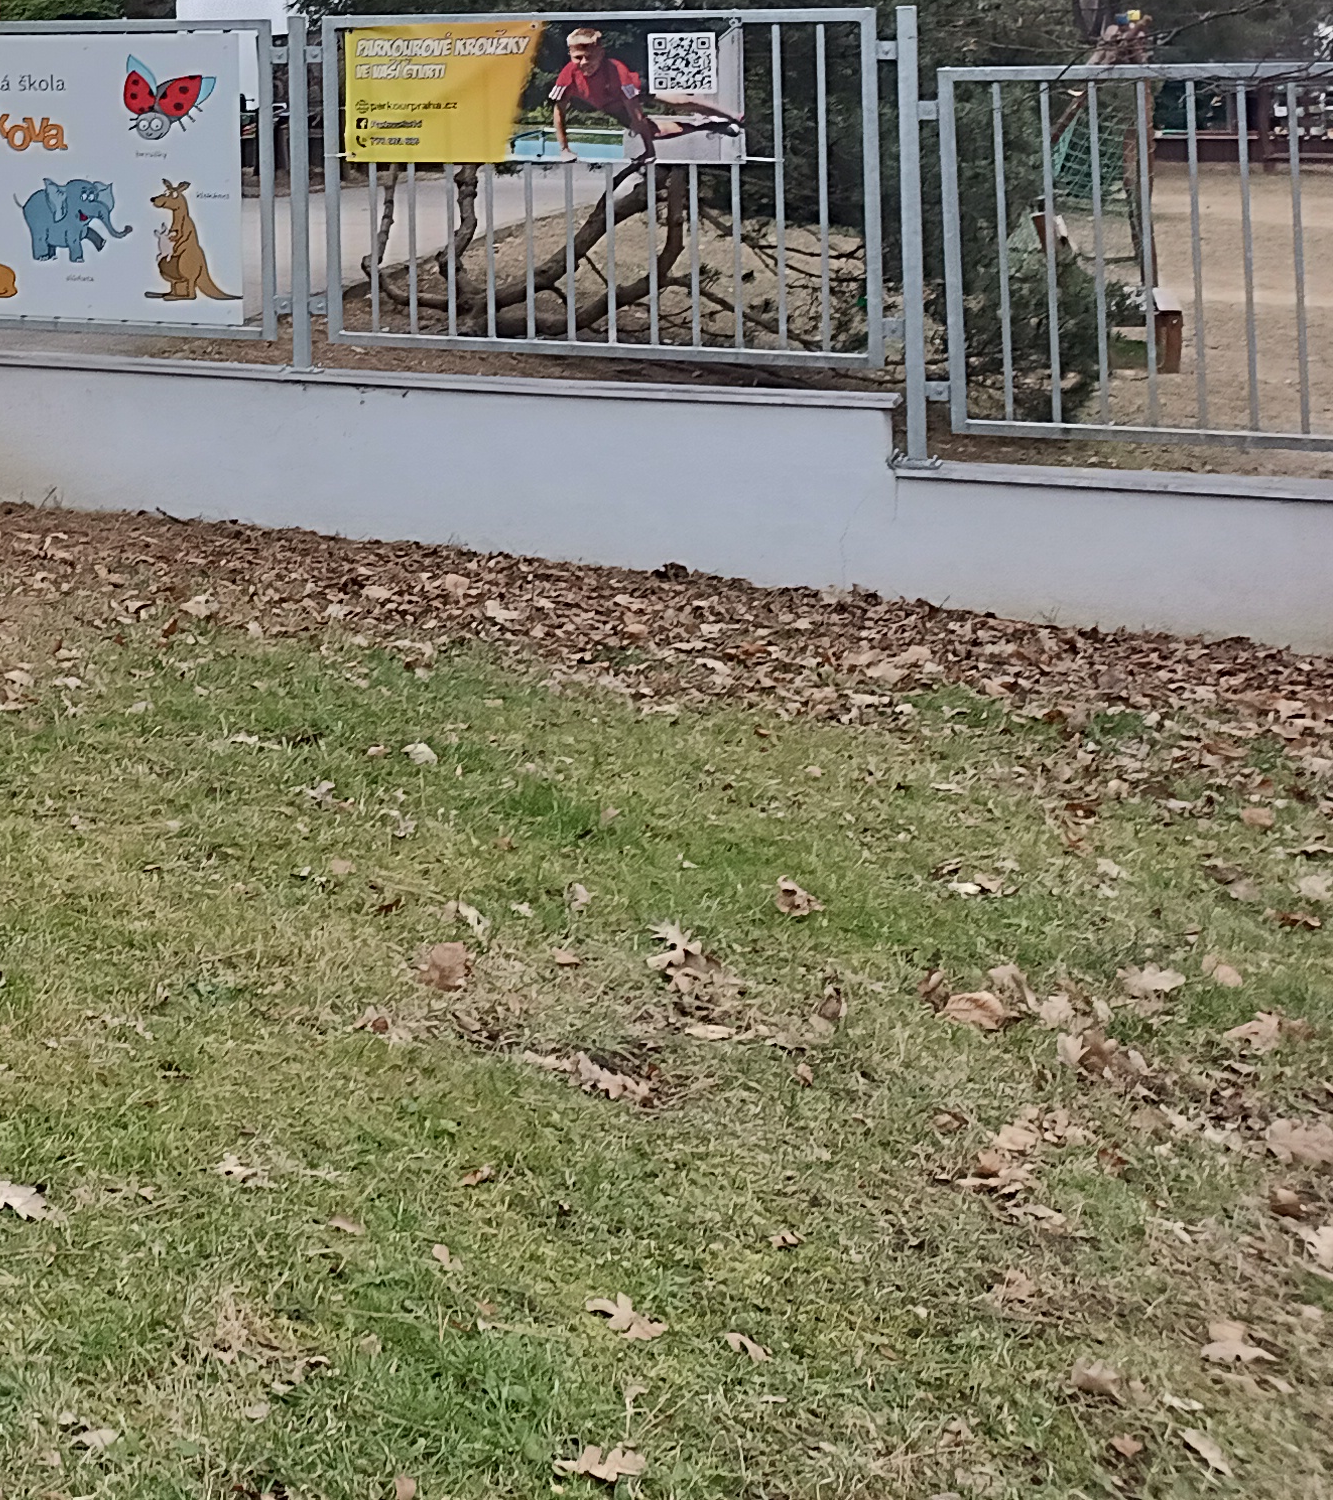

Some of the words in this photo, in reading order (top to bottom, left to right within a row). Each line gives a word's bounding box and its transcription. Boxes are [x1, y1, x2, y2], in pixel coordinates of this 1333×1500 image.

[355, 31, 453, 58] PARKOUROVÉ
[453, 29, 531, 58] KROUŽKY
[355, 64, 371, 80] VE
[17, 74, 67, 92] škola
